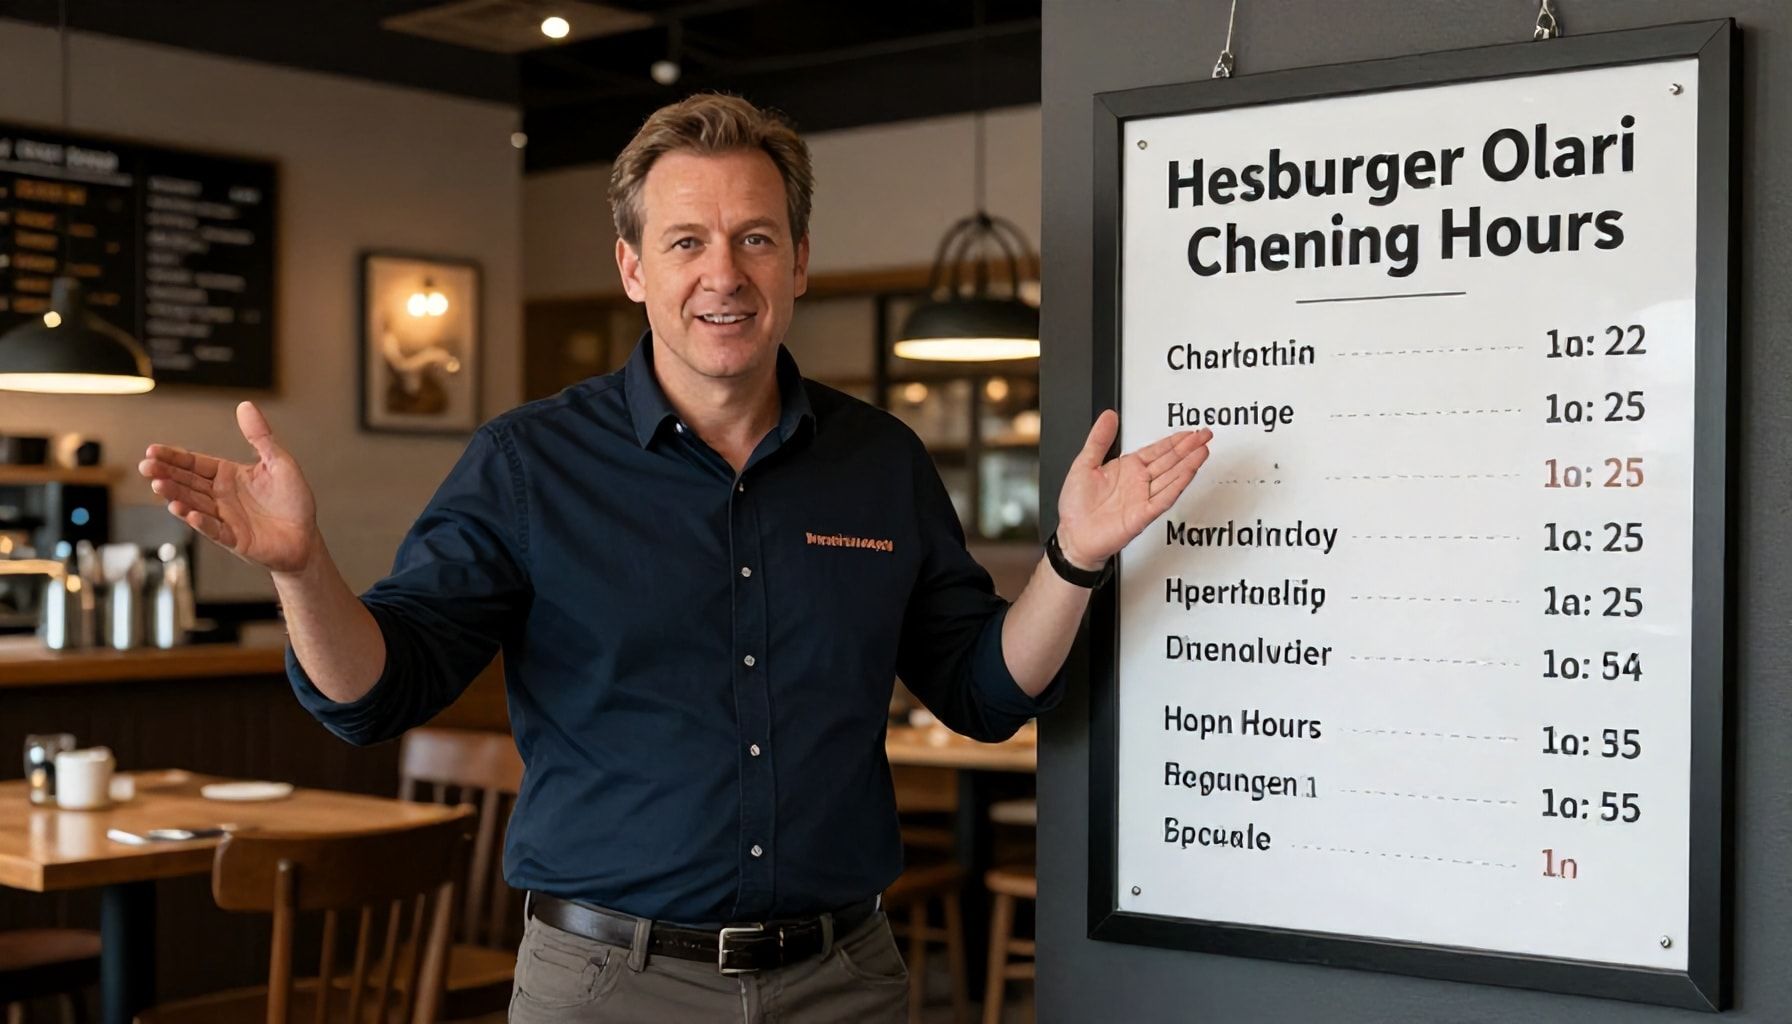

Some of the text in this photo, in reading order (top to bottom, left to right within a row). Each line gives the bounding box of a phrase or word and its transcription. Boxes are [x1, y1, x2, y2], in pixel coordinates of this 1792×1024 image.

[1168, 115, 1636, 206] Hesburger Olari
[1187, 206, 1625, 278] Chening Hours
[1604, 324, 1647, 356] 22
[1604, 390, 1646, 422] 25
[1603, 457, 1644, 488] 25
[1602, 522, 1644, 552] 25
[1602, 586, 1644, 618] 25
[1602, 651, 1644, 682] 54
[1240, 709, 1322, 740] Hours
[1600, 791, 1642, 823] 55
